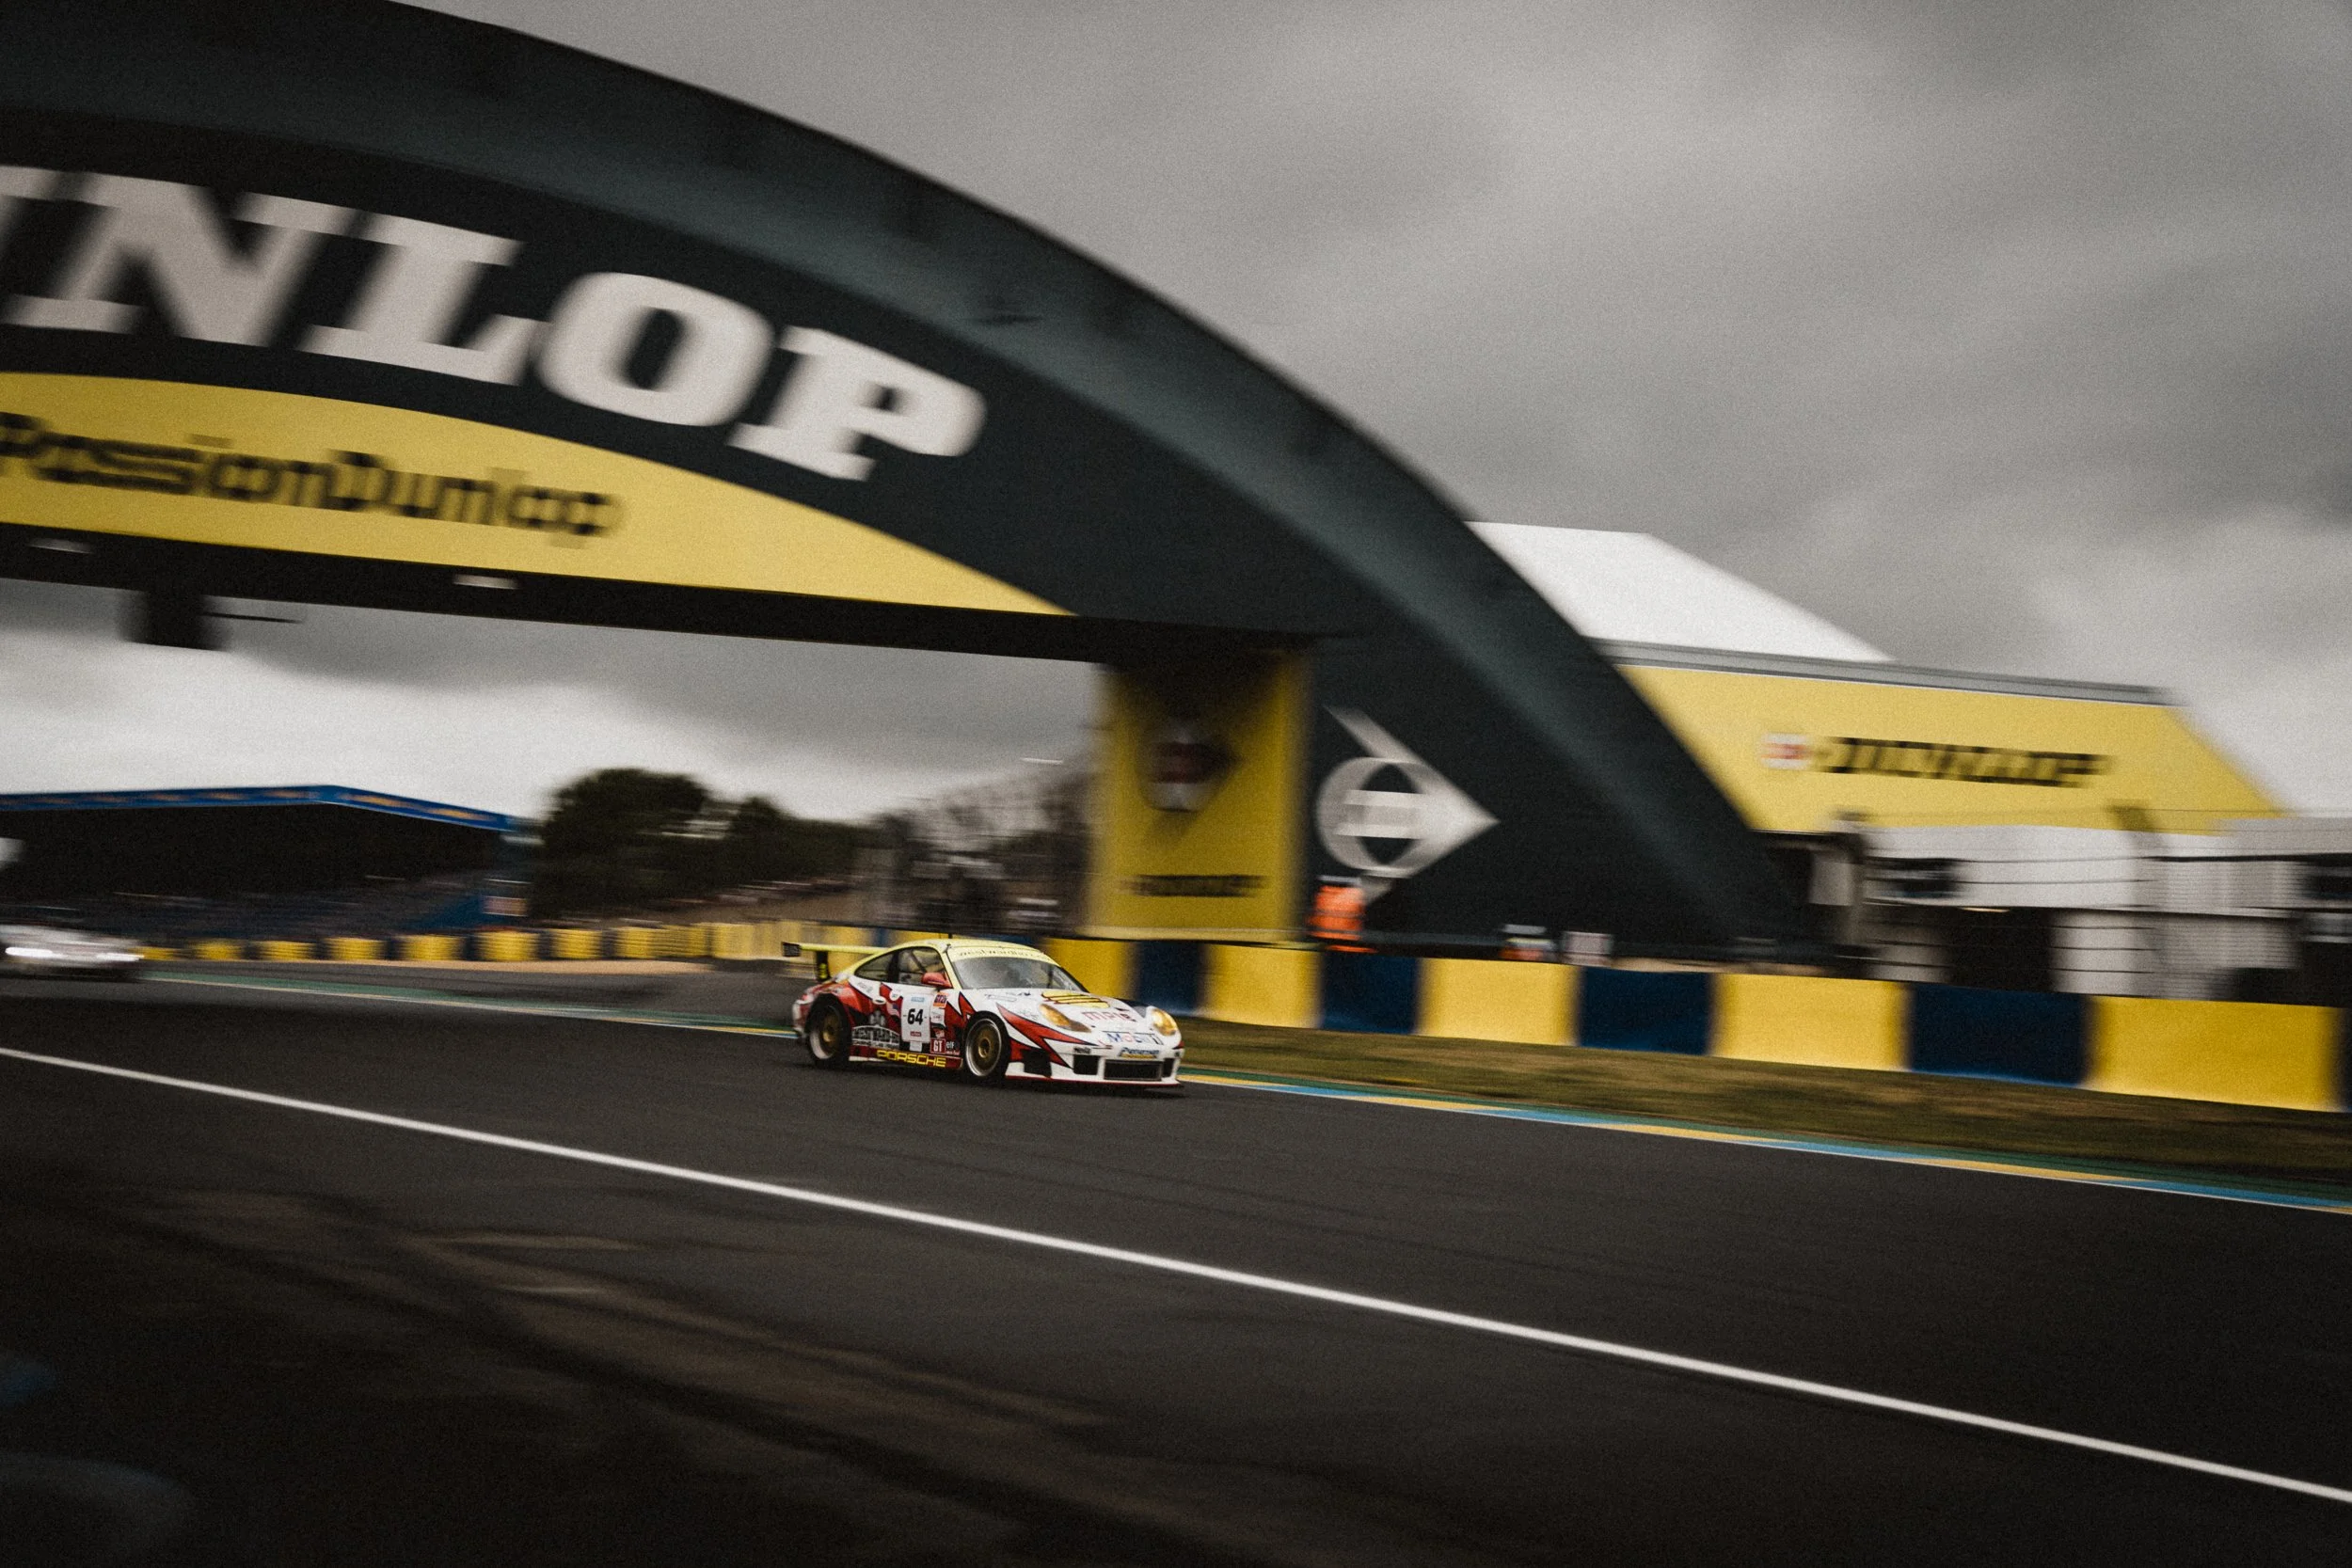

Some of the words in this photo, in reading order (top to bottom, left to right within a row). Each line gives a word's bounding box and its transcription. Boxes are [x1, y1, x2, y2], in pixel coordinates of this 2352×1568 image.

[0, 166, 988, 481] NLOP
[907, 1008, 924, 1026] 64
[933, 1039, 944, 1053] GT
[877, 1050, 946, 1068] PORSCHE
